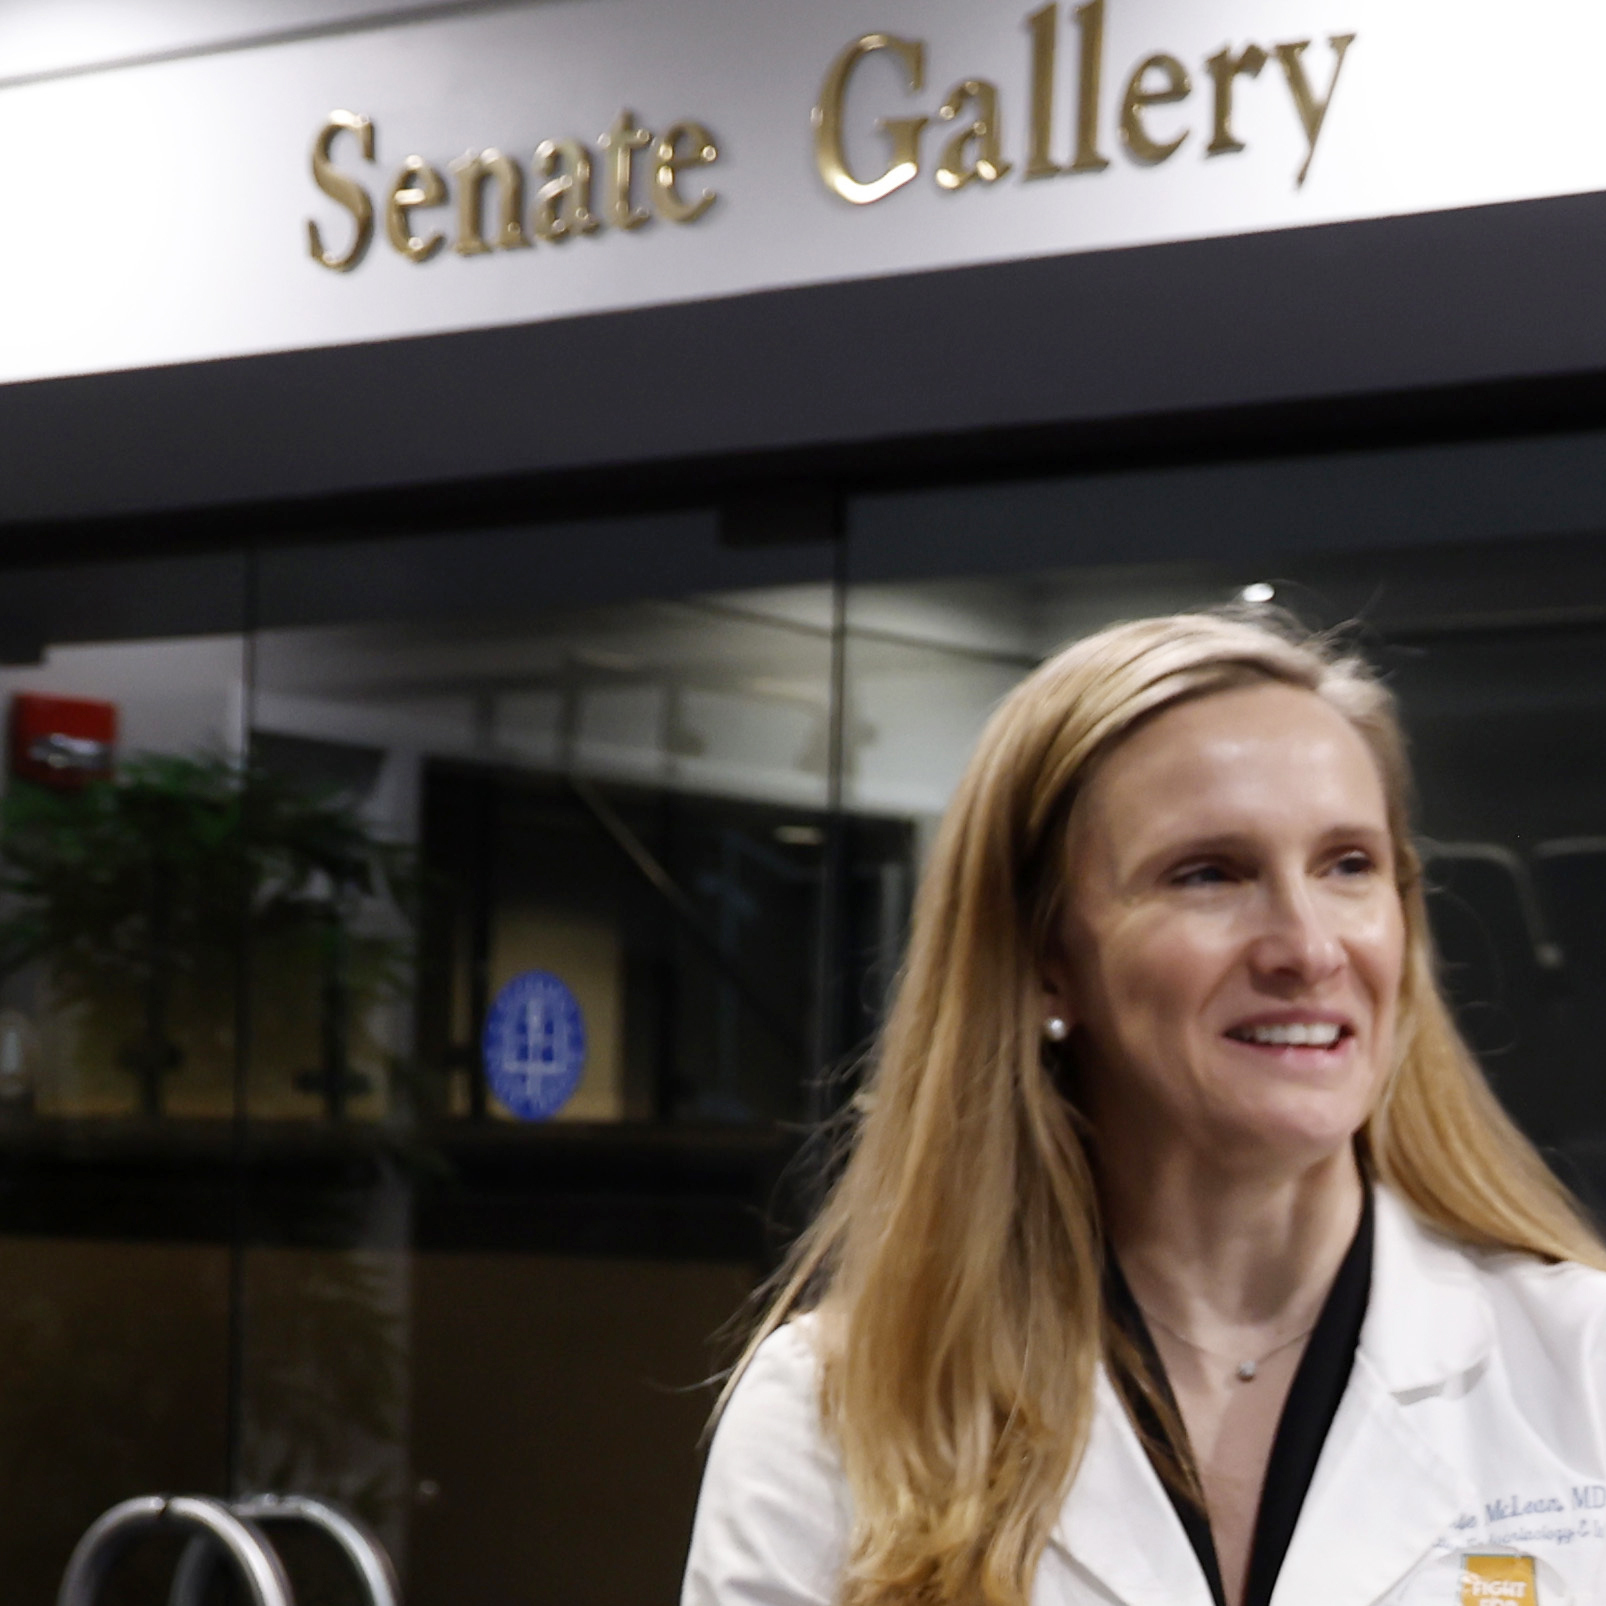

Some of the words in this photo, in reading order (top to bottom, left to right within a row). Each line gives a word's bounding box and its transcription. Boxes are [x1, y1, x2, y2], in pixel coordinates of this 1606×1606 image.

[306, 107, 717, 274] Senate
[809, 0, 1357, 205] Gallery
[1572, 1485, 1606, 1510] MD
[1471, 1581, 1527, 1598] FIGHT
